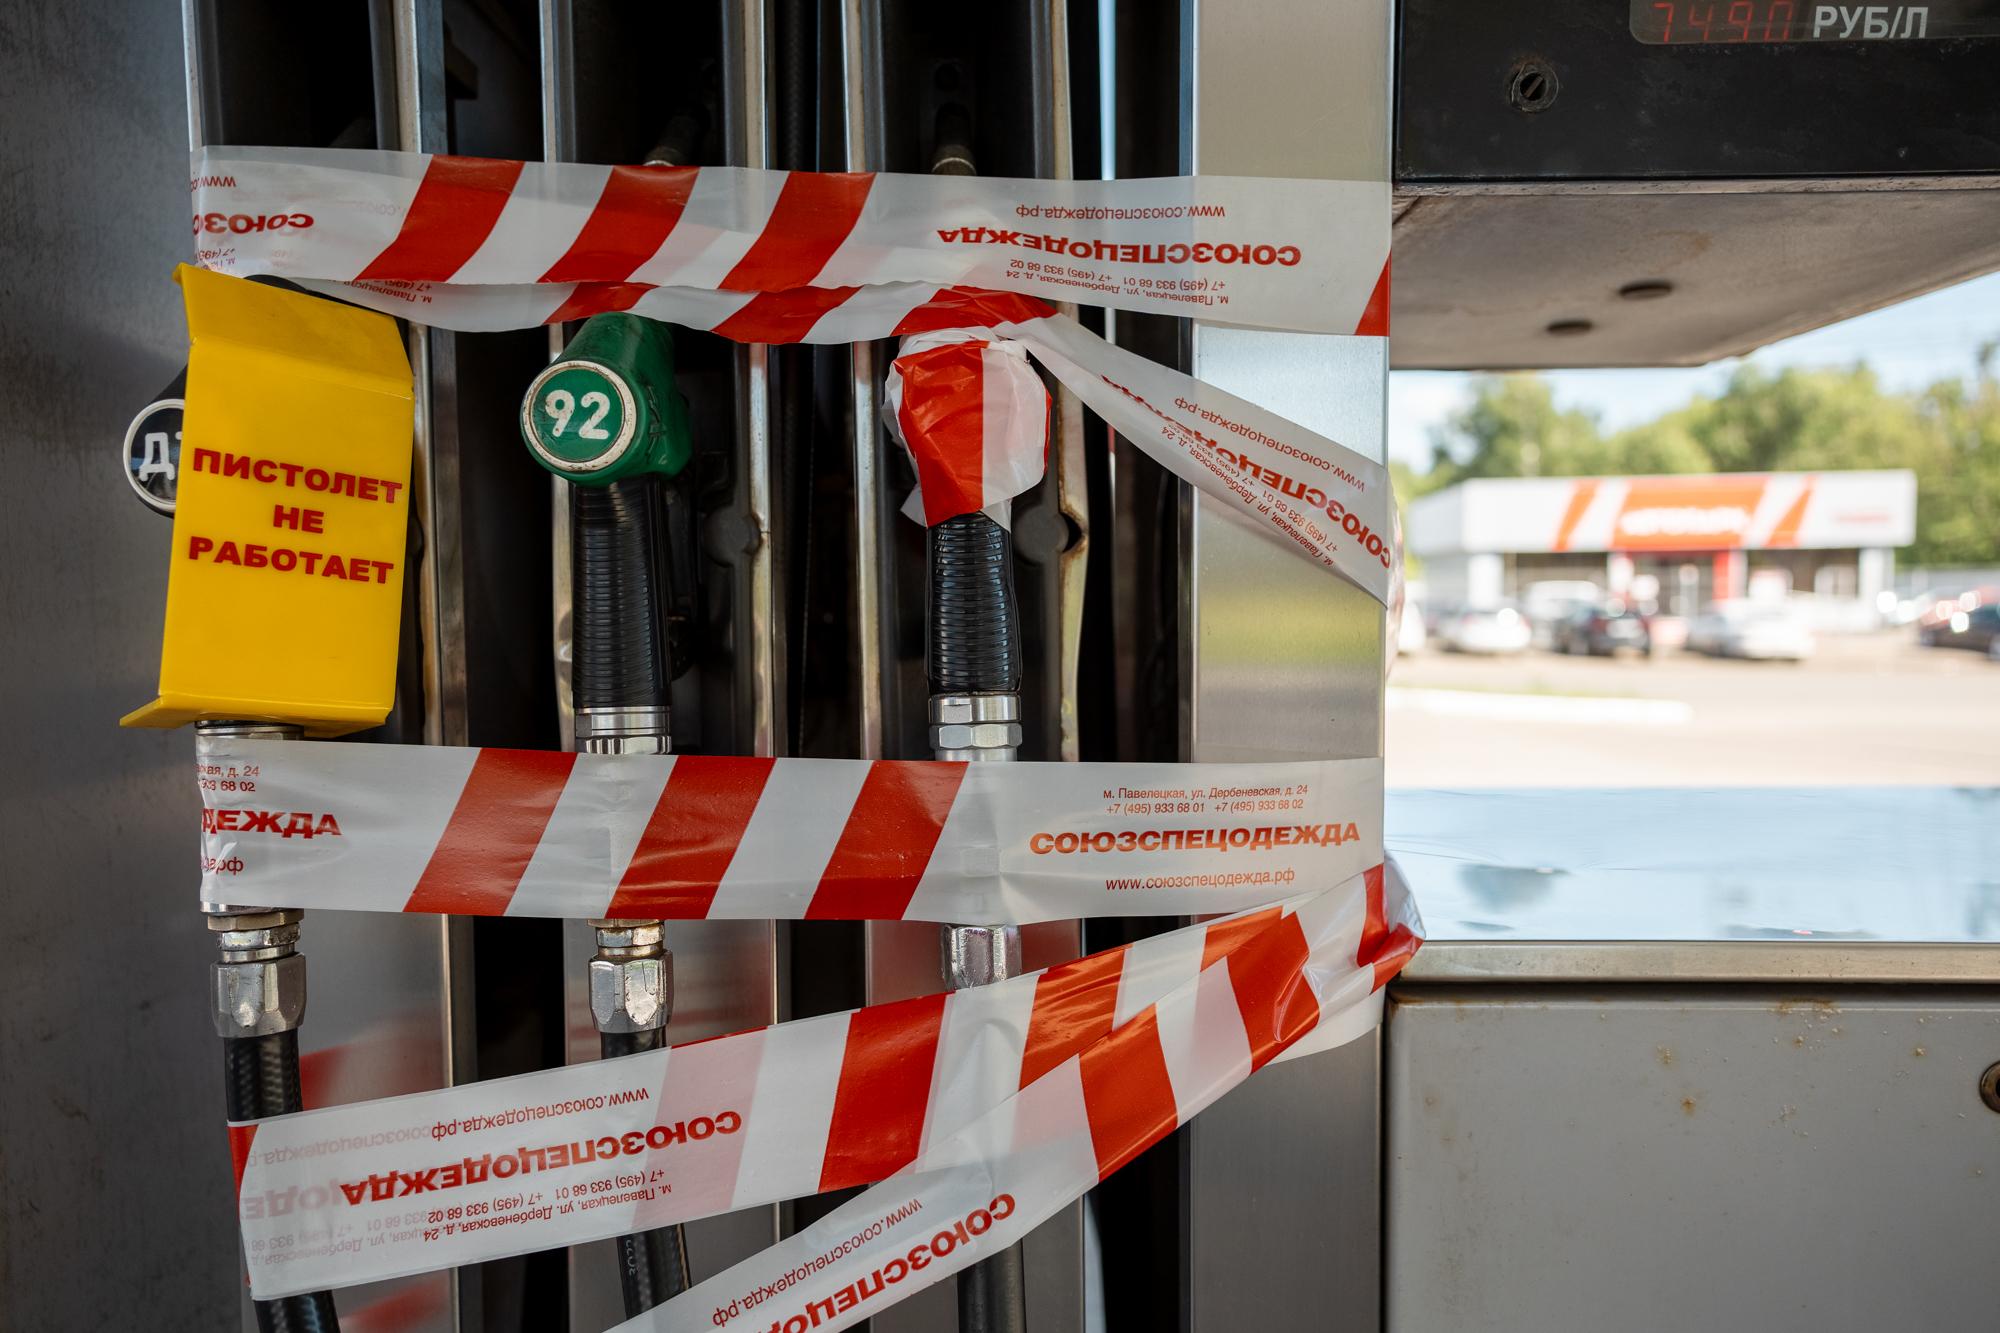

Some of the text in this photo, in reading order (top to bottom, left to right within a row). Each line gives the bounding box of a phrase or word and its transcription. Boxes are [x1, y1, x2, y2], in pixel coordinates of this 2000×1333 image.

[1812, 5, 1929, 40] РУБ/Л
[1016, 204, 1226, 220] www.союзспецодежда.рф
[937, 226, 1302, 267] СОЮЗСПЕЦОДЕЖДА
[1006, 269, 1020, 279] 24
[1010, 258, 1226, 291] +7 (495) 933 68 01 +7 (495) 933 68 02
[1036, 274, 1121, 294] Дербеневская,
[1123, 287, 1140, 296] ул.
[1142, 289, 1214, 306] Павелецкая,
[1217, 295, 1229, 304] м.
[545, 389, 611, 440] 92
[1161, 425, 1176, 441] 24
[1174, 396, 1366, 493] www.союзспецодежда.рф
[138, 431, 183, 482] Д
[192, 447, 403, 504] ПИСТОЛЕТ
[1189, 444, 1258, 506] Дербеневская,
[1256, 500, 1271, 516] ул.
[1262, 489, 1275, 503] 01
[1274, 500, 1288, 513] 68
[272, 503, 325, 534] НЕ
[1287, 509, 1306, 527] 933
[1304, 521, 1328, 545] (495)
[188, 535, 394, 584] РАБОТАЕТ
[226, 766, 239, 778] д.
[243, 765, 260, 777] 24
[220, 779, 237, 792] 68
[239, 780, 256, 792] 02
[1103, 789, 1115, 799] м.
[1118, 787, 1188, 800] Павелецкая,
[1190, 789, 1206, 801] ул.
[1208, 786, 1283, 799] Дербеневская,
[1296, 784, 1308, 796] 24
[1106, 798, 1304, 816] +7 (495) 933 68 01 +7 (495) 933 68 02
[1029, 822, 1361, 855] СОЮЗСПЕЦОДЕЖДА
[1105, 867, 1295, 891] www.союзспецодежда.рф
[431, 1087, 649, 1142] www.союзспецодежда.рф
[340, 1110, 742, 1206] СОЮЗСПЕЦОДЕЖДА
[427, 1168, 665, 1224] +7 (495) 933 68 01 +7 (495) 933 68 02
[577, 1187, 655, 1211] Павелецкая,
[658, 1183, 673, 1194] м.
[458, 1206, 553, 1234] Дербеневская,
[556, 1202, 575, 1216] ул.
[423, 1228, 440, 1242] 24
[711, 1198, 922, 1328] www.союзспецодежда.рф
